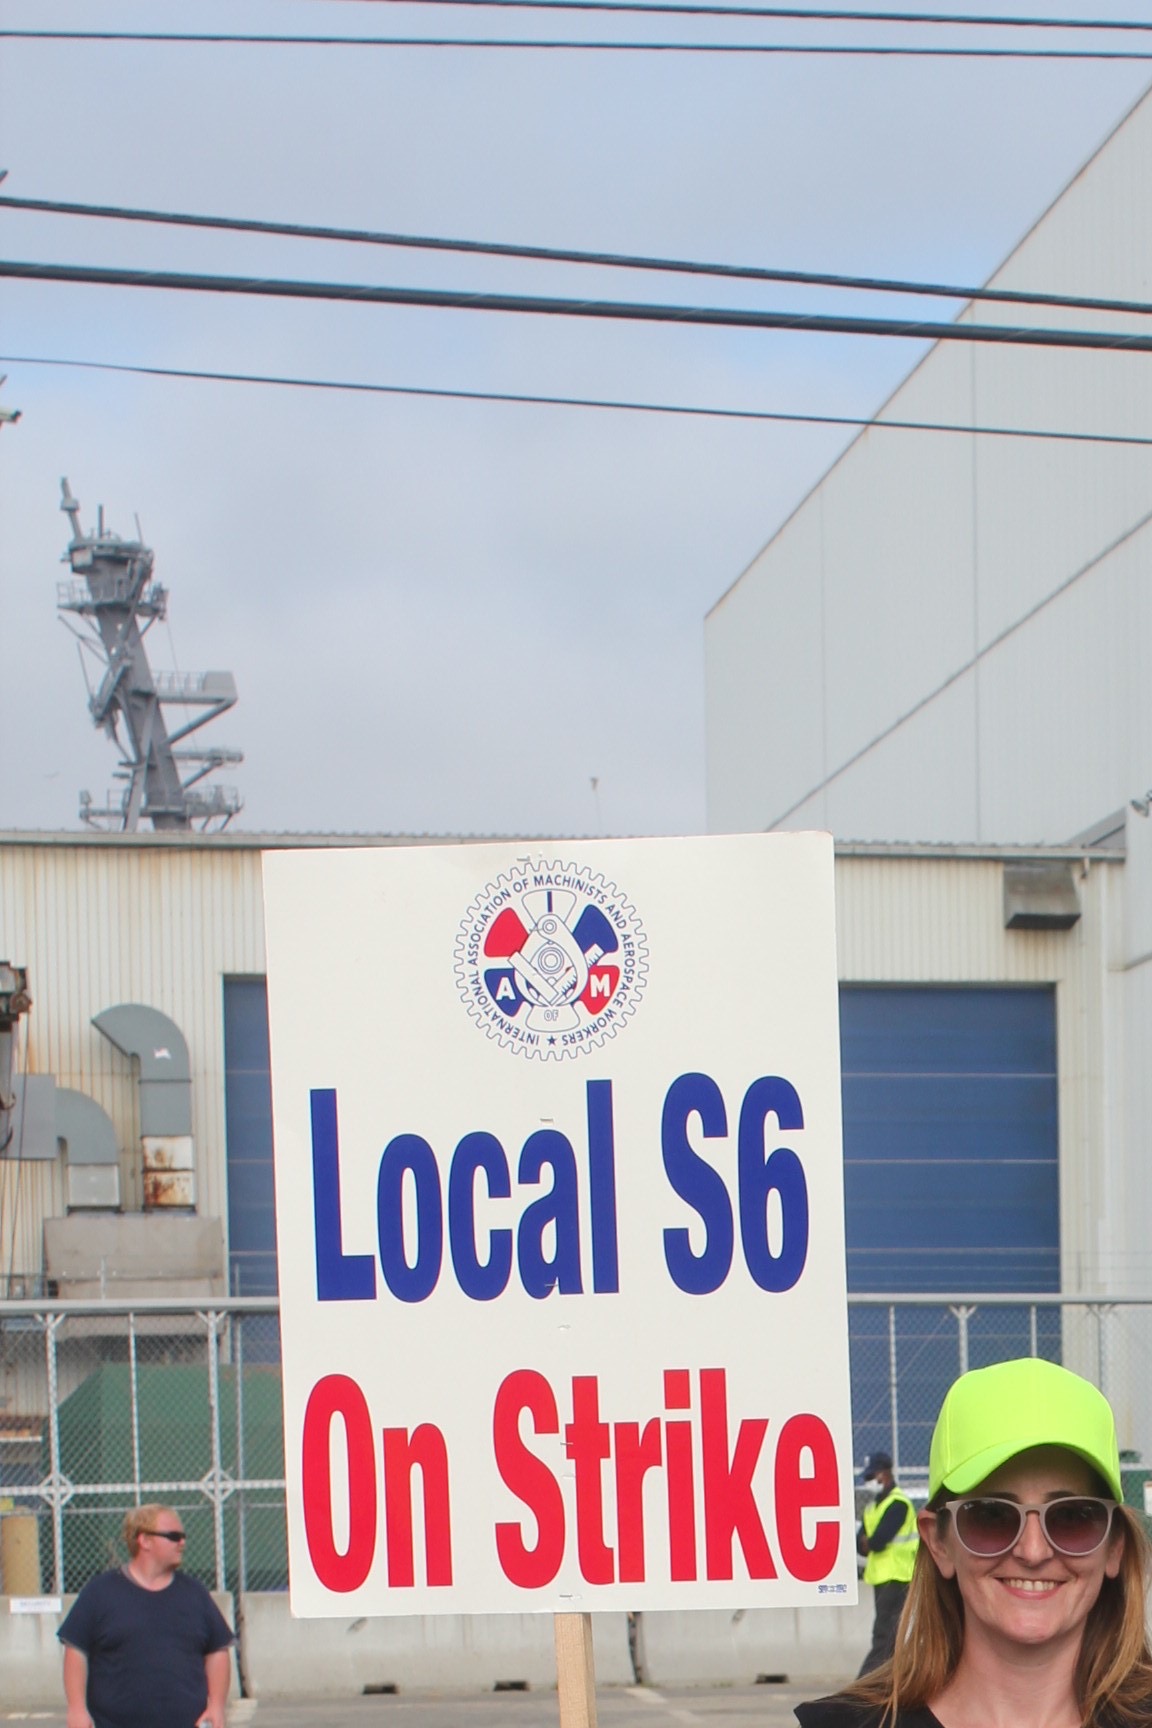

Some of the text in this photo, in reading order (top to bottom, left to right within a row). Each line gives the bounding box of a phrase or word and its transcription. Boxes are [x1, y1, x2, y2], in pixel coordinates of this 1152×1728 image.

[467, 873, 636, 1046] INTERNATIONAL ASSOCIATION OF MACHINISTS AND AEROSPACE WORKERS
[495, 973, 611, 1001] A M
[309, 1072, 810, 1303] Local S6
[302, 1368, 842, 1594] On Strike
